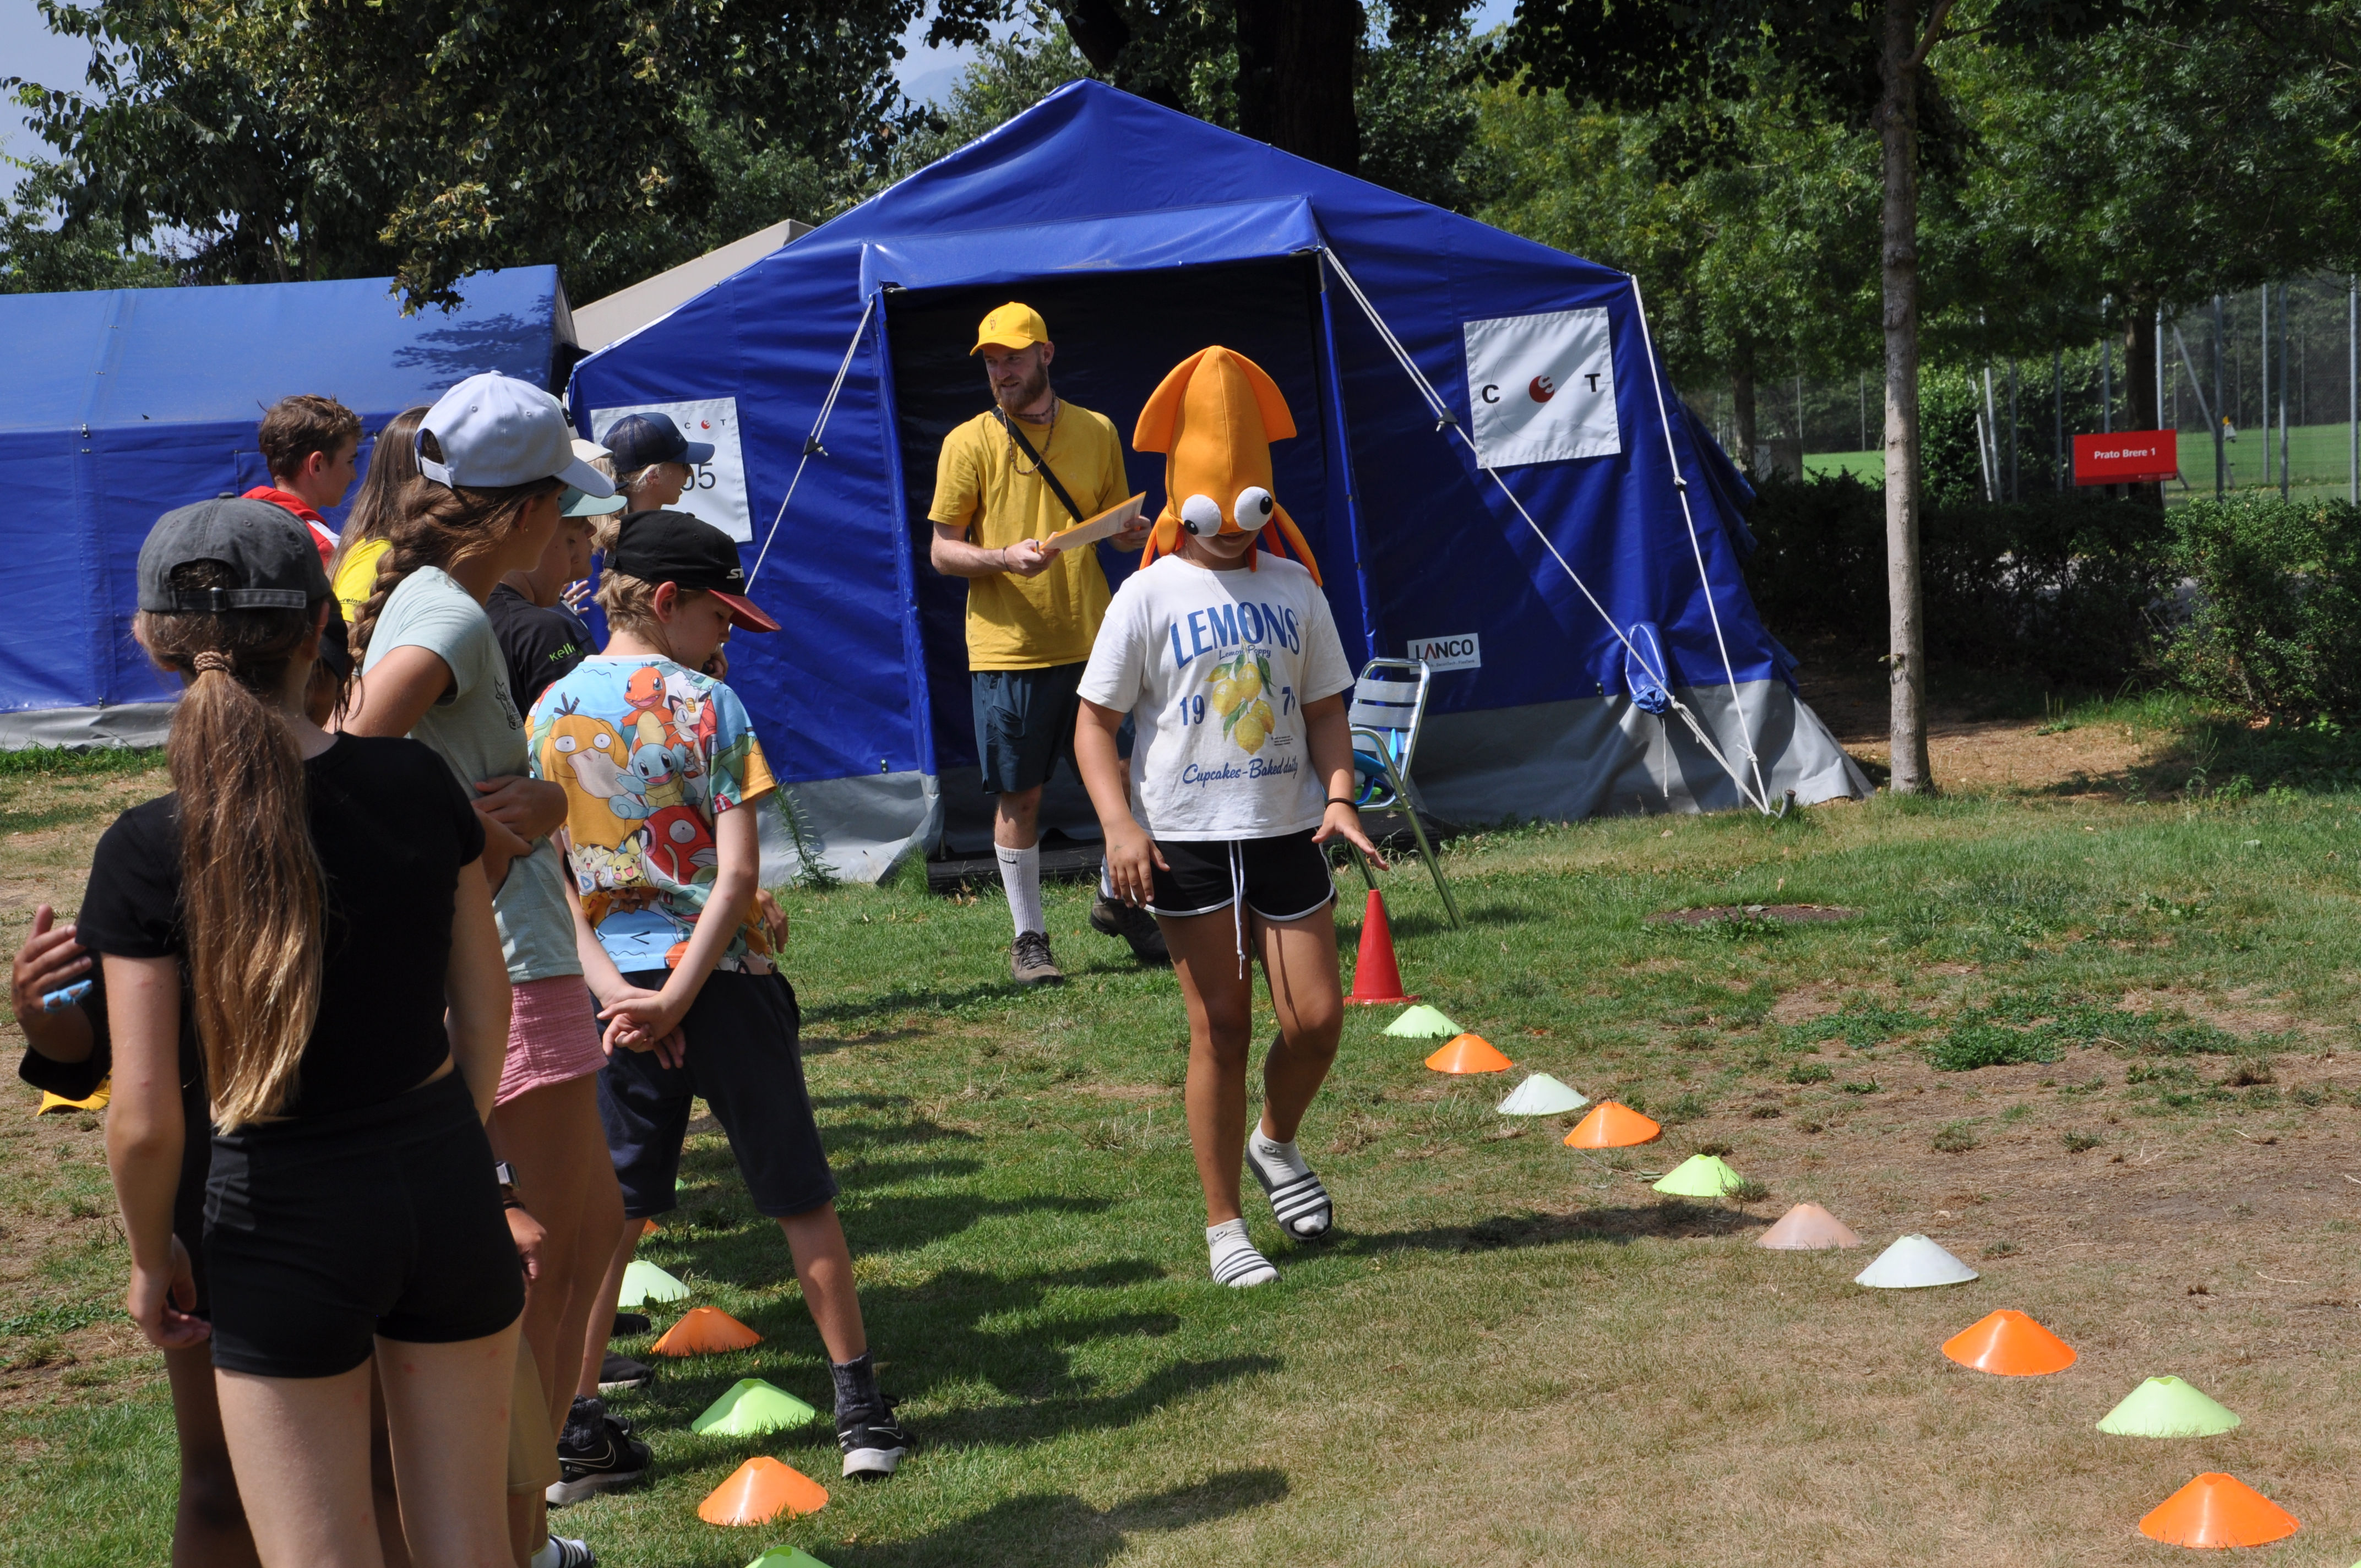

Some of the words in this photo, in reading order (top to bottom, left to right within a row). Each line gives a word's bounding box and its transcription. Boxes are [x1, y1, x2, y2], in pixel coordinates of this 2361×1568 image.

[2094, 450, 2120, 459] Prato
[2123, 449, 2147, 458] Brere
[2150, 447, 2156, 456] 1
[1170, 602, 1300, 670] LEMONS
[1219, 649, 1245, 661] Lemon
[1248, 644, 1271, 658] Poppy
[1415, 639, 1474, 661] LANCO
[1179, 694, 1205, 726] 19
[1283, 755, 1298, 779] daily
